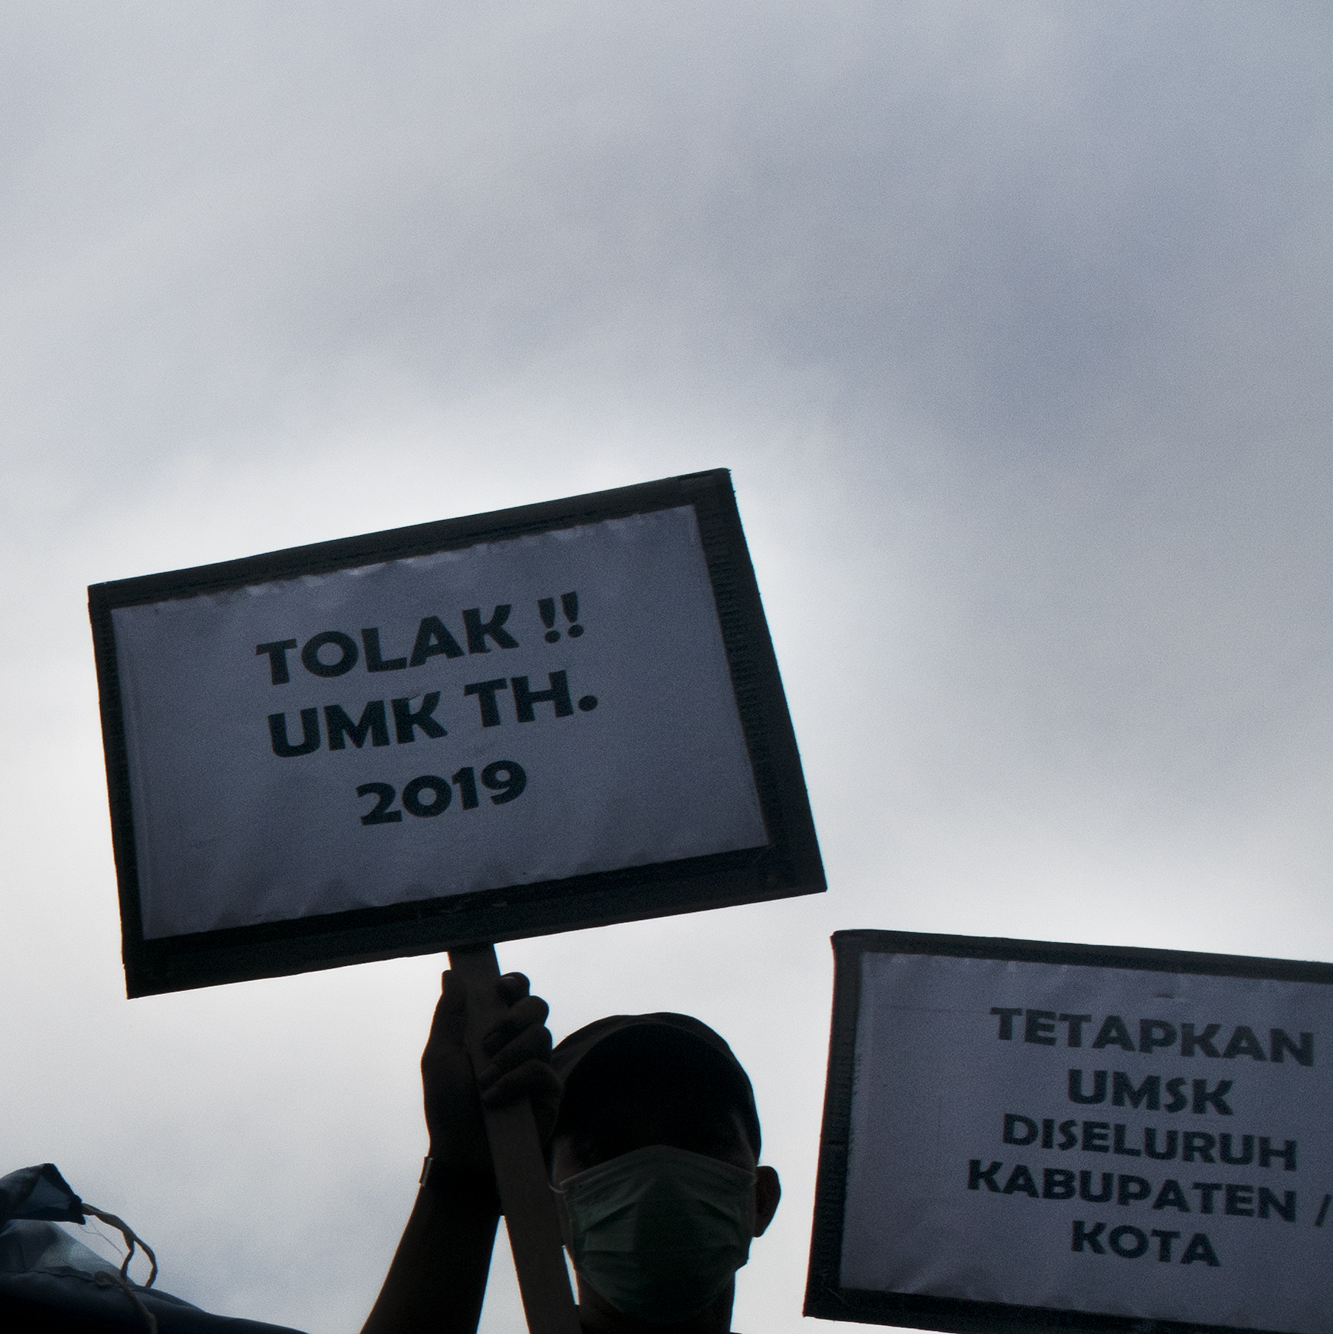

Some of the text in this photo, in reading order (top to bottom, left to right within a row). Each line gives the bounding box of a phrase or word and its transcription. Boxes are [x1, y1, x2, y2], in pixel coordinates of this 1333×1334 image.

[256, 591, 584, 685] TOLAK !!
[269, 670, 598, 757] UMK TH.
[357, 760, 528, 825] 2019
[990, 1007, 1314, 1067] TETAPKAN
[1068, 1069, 1233, 1116] UMSK
[1003, 1113, 1297, 1171] DISELURUH
[967, 1159, 1297, 1223] KABUPATEN
[1071, 1220, 1222, 1267] KOTA
